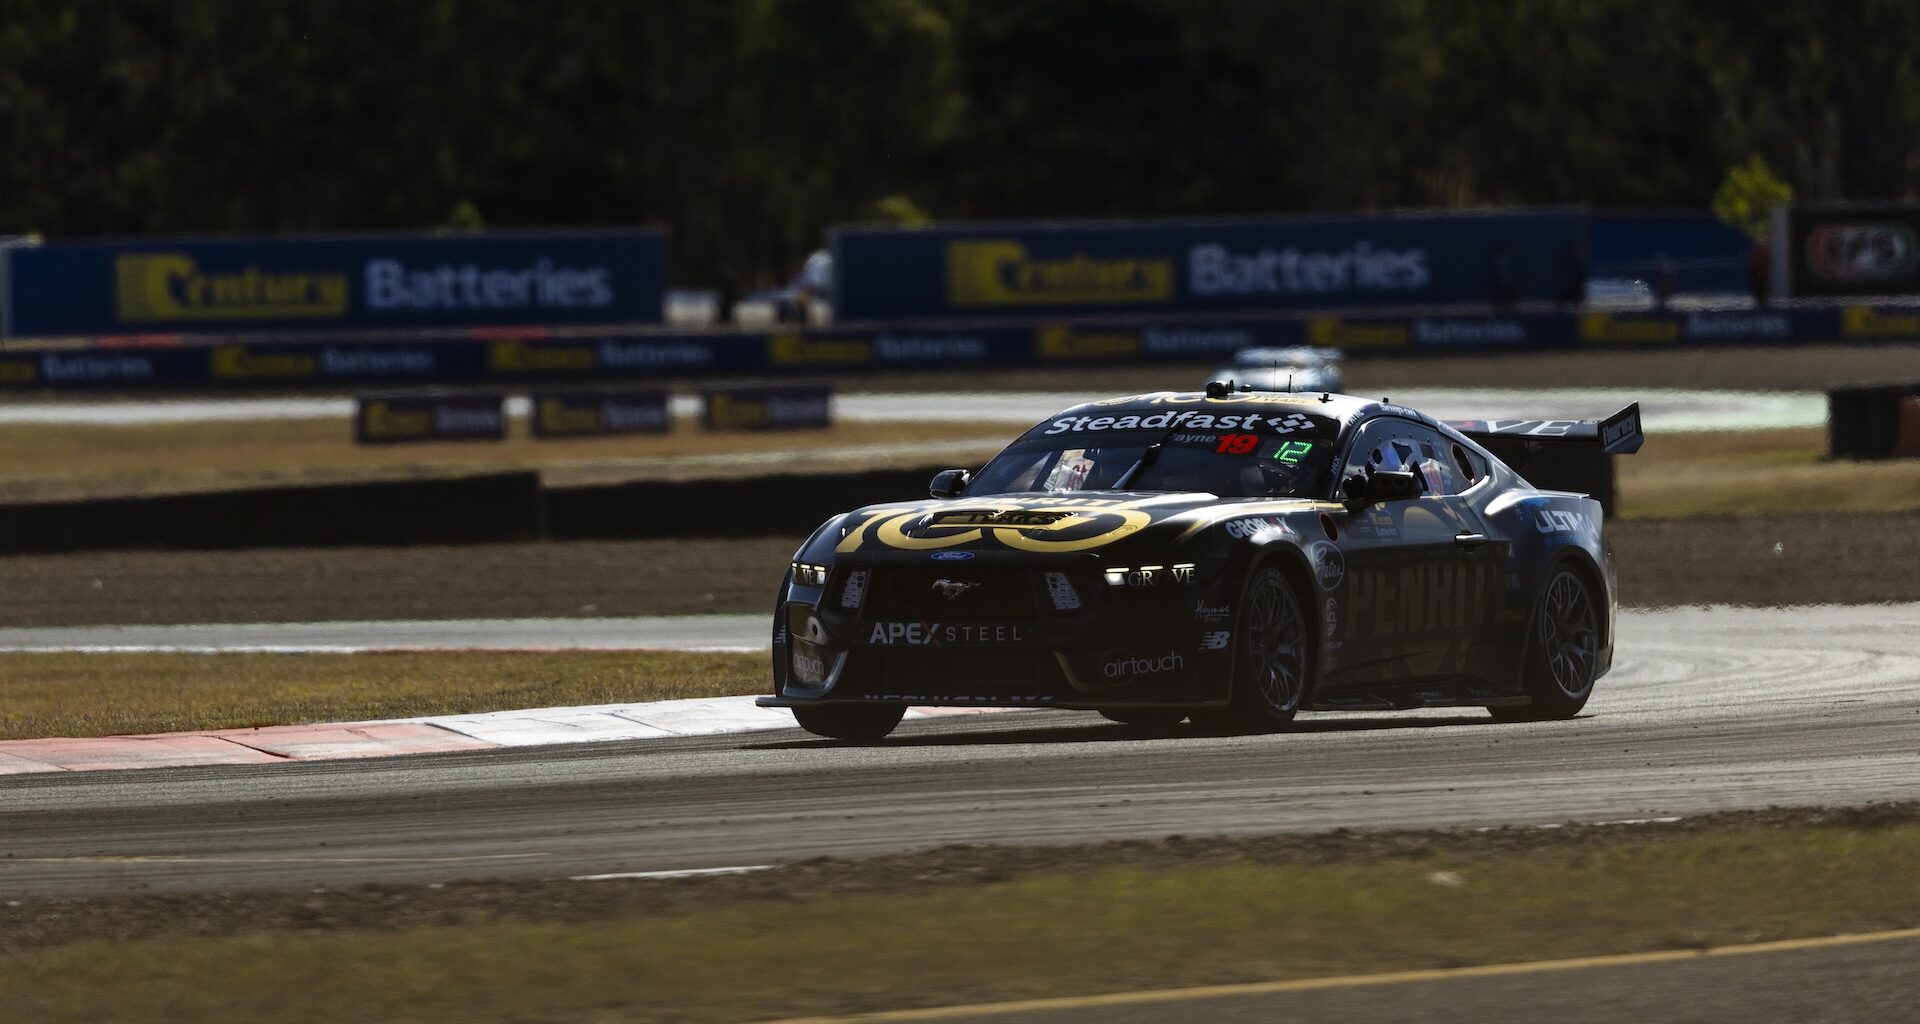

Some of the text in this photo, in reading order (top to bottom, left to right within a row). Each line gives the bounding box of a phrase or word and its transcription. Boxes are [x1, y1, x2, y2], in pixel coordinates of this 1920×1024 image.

[1188, 242, 1430, 295] Batteries
[365, 258, 611, 308] Batteries
[1044, 411, 1263, 435] Steadfast
[1173, 433, 1259, 455] ayne 19
[1272, 439, 1314, 464] 12
[1535, 510, 1600, 539] ULTIMA
[1128, 567, 1196, 587] GRVE
[869, 622, 1022, 649] APEX STEEL
[1104, 651, 1184, 678] airtouch
